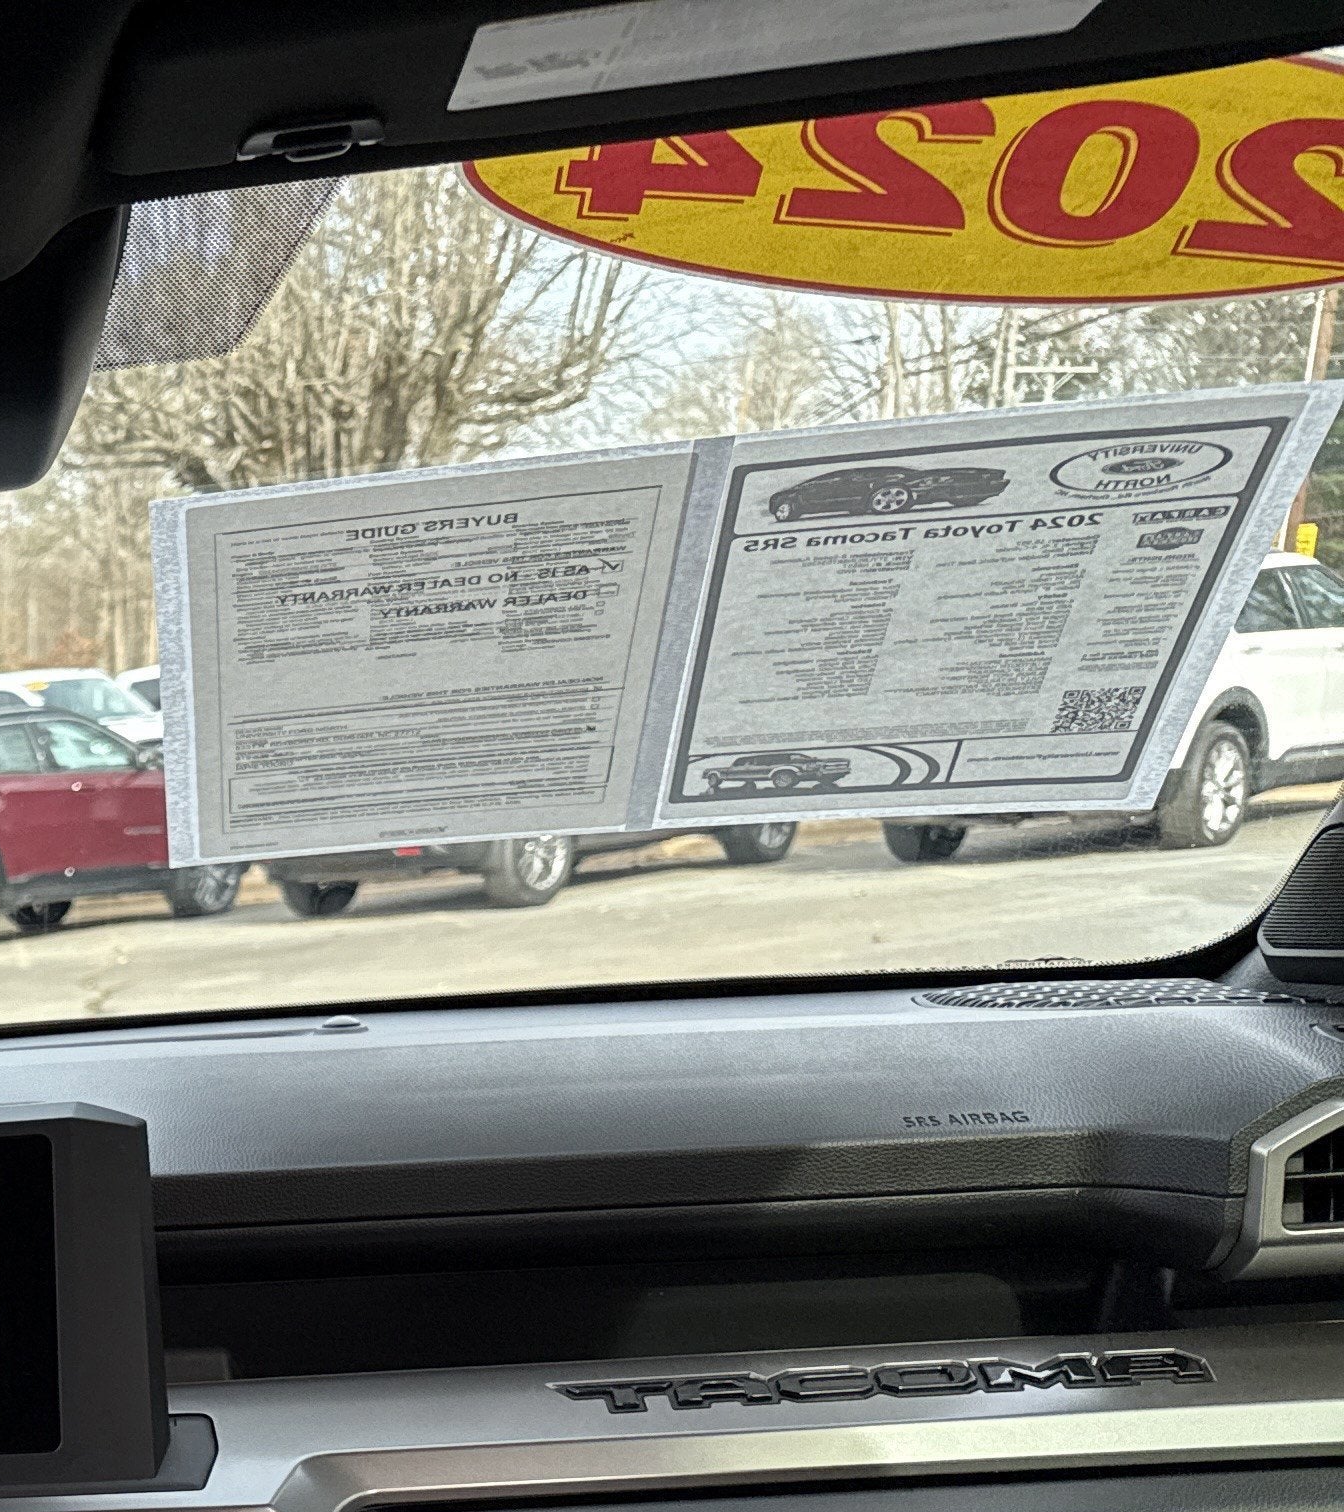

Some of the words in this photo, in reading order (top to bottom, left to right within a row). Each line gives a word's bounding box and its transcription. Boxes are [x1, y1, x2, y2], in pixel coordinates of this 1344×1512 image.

[902, 1115, 941, 1128] SRS
[948, 1111, 1030, 1126] AIRBAG
[544, 1346, 1219, 1415] TACOMA
